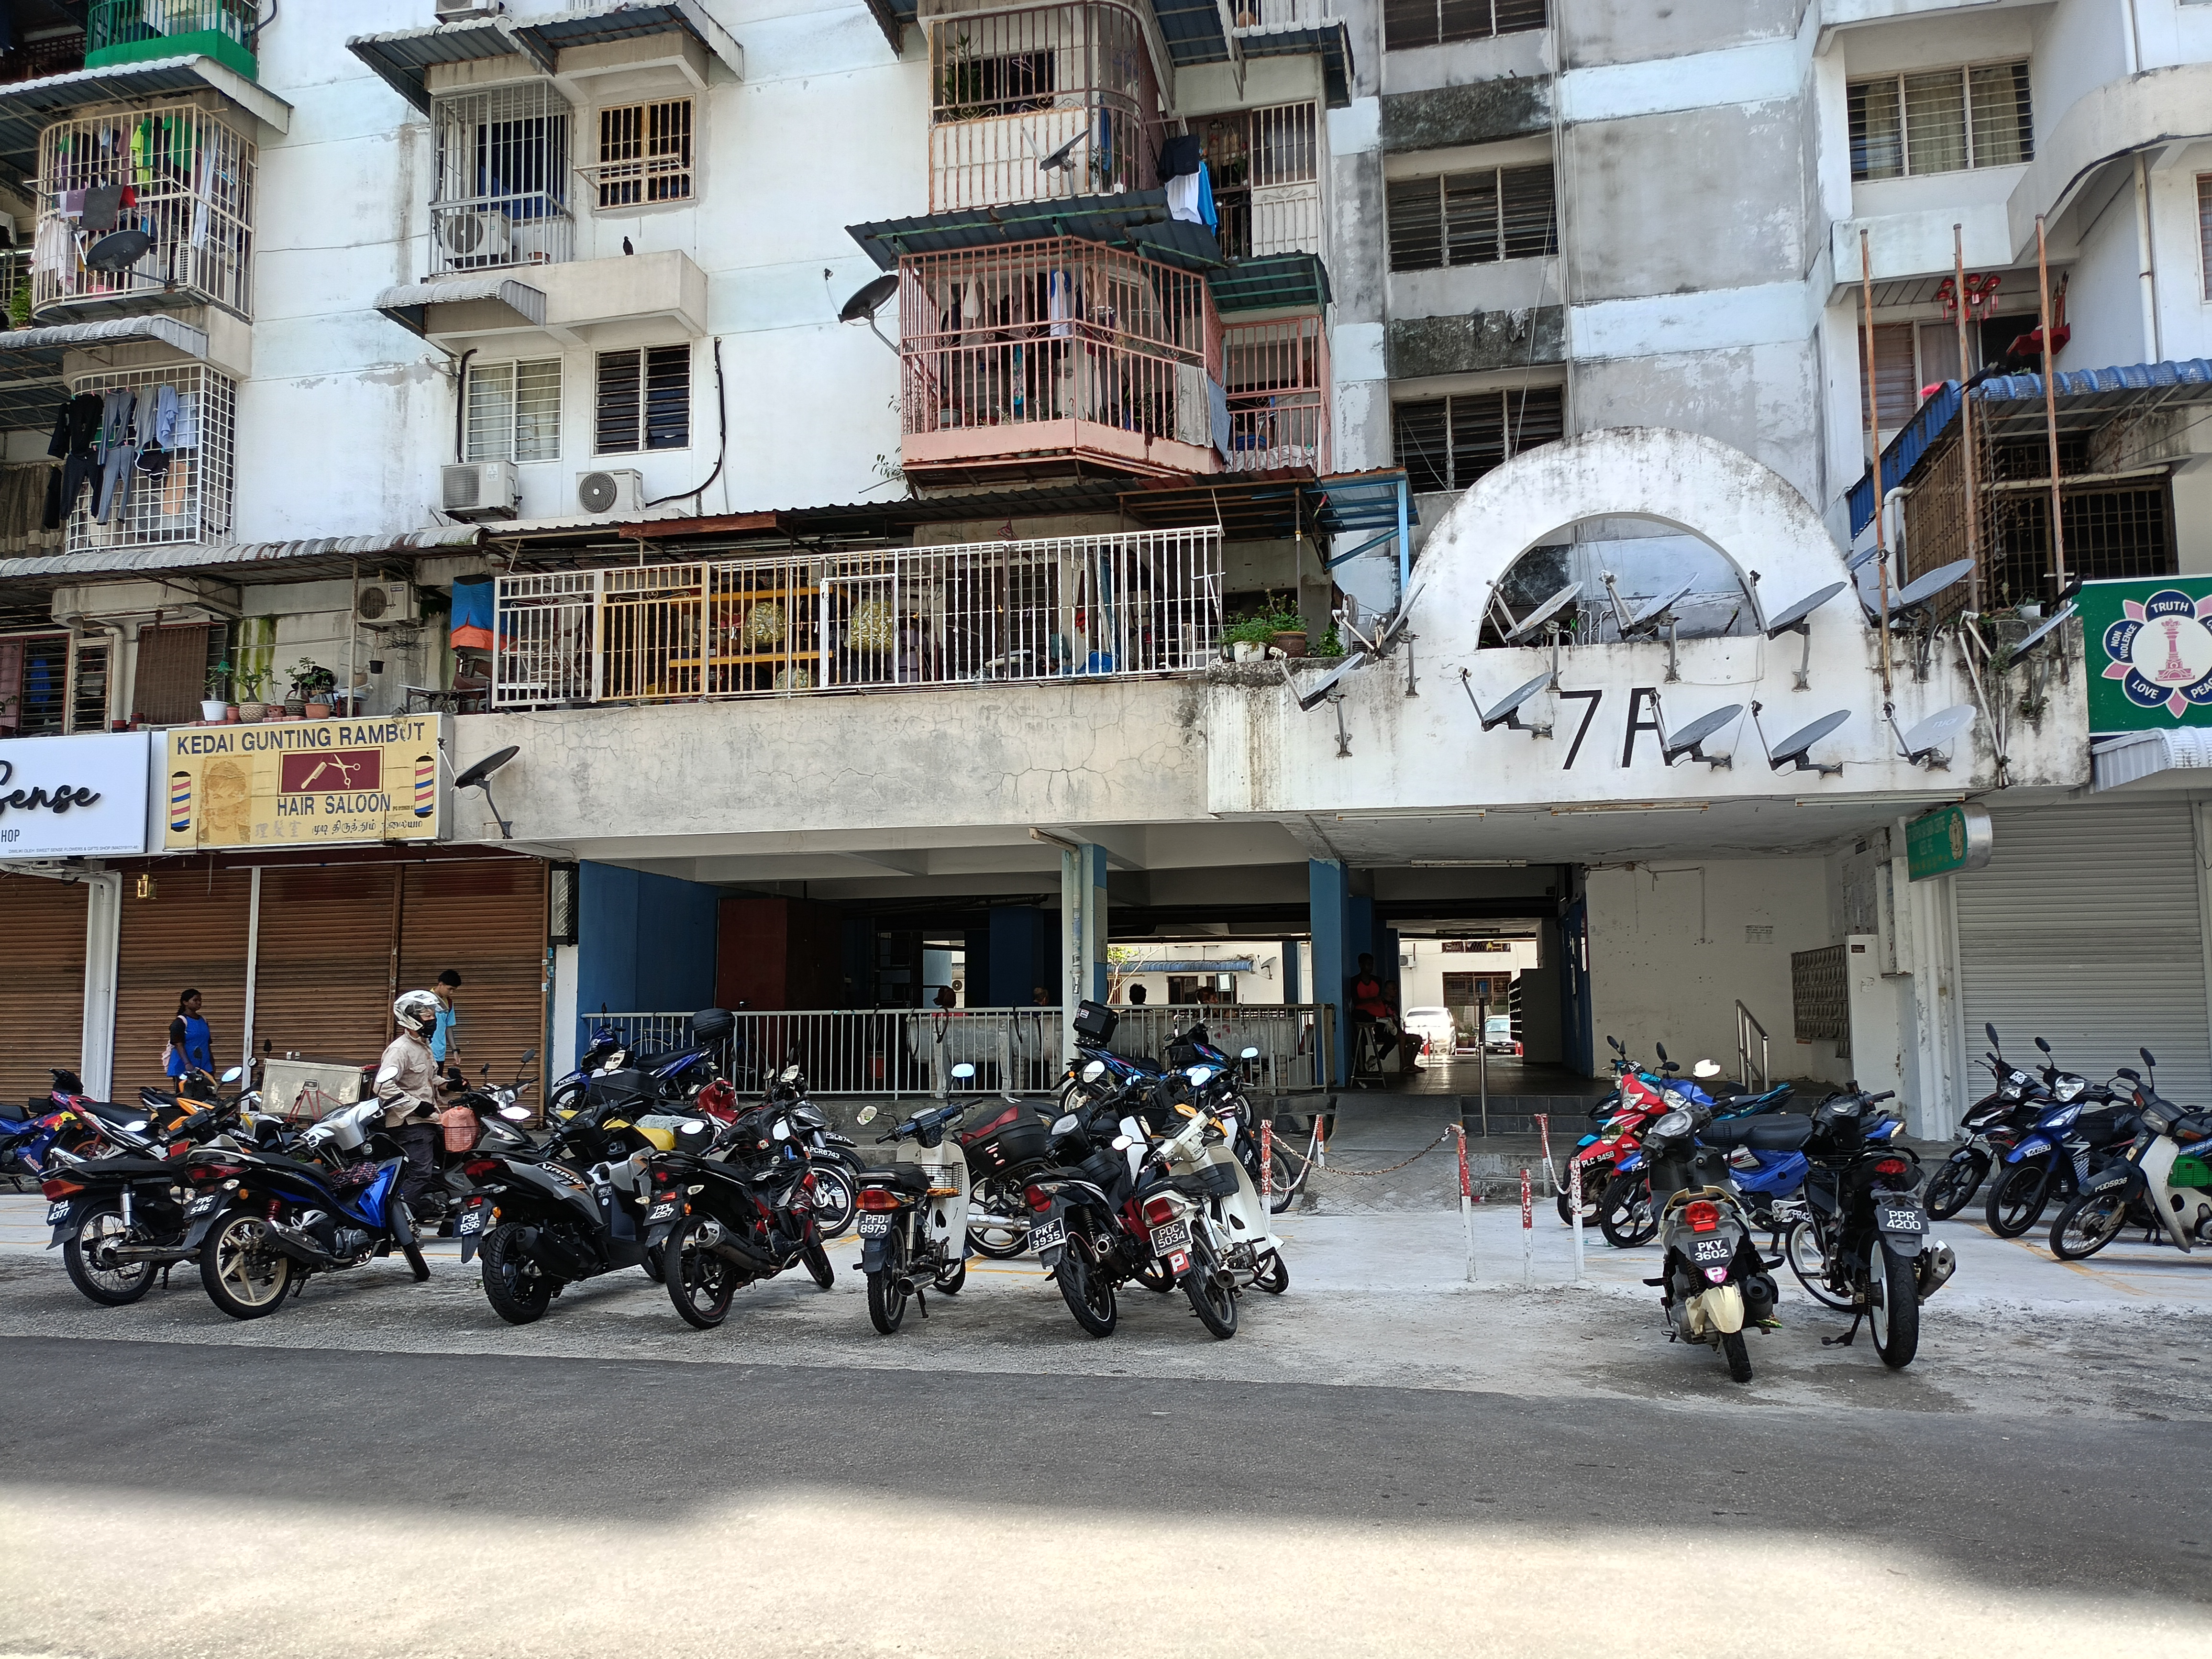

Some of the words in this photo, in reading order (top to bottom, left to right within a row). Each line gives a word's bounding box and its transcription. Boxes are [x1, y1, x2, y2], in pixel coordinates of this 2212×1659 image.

[2151, 601, 2189, 613] TRUTH
[2111, 630, 2122, 647] NON
[2120, 623, 2137, 659] VIOLENCE
[2132, 679, 2159, 699] LOVE
[177, 734, 233, 754] KEDAI
[242, 728, 331, 751] GUNTING
[340, 722, 425, 745] RAMBUT
[278, 797, 314, 816] HAIR
[325, 793, 391, 814] SALOON
[0, 830, 20, 842] HOP
[809, 1146, 840, 1159] PCR6743
[1581, 1157, 1595, 1168] PLC
[1597, 1150, 1615, 1162] 9458
[23, 1157, 38, 1172] HONDA
[542, 1163, 582, 1184] VARIO
[2095, 1177, 2127, 1193] PDD5936
[53, 1200, 68, 1212] PGA
[190, 1203, 210, 1215] 546
[655, 1203, 673, 1212] PPL
[48, 1207, 70, 1221] 4377
[462, 1212, 479, 1224] PSA
[650, 1208, 675, 1219] 4257
[865, 1214, 885, 1224] PFD
[1889, 1210, 1915, 1220] PPR
[460, 1220, 480, 1233] 1556
[860, 1224, 887, 1233] 8979
[1035, 1223, 1055, 1239] PKF
[1159, 1224, 1180, 1238] PDC
[1886, 1219, 1921, 1230] 4200
[1033, 1230, 1061, 1249] 3935
[1158, 1230, 1185, 1248] 5034
[1697, 1240, 1722, 1251] PKY
[1694, 1249, 1729, 1261] 3602
[1170, 1253, 1184, 1272] P
[1706, 1267, 1723, 1281] P
